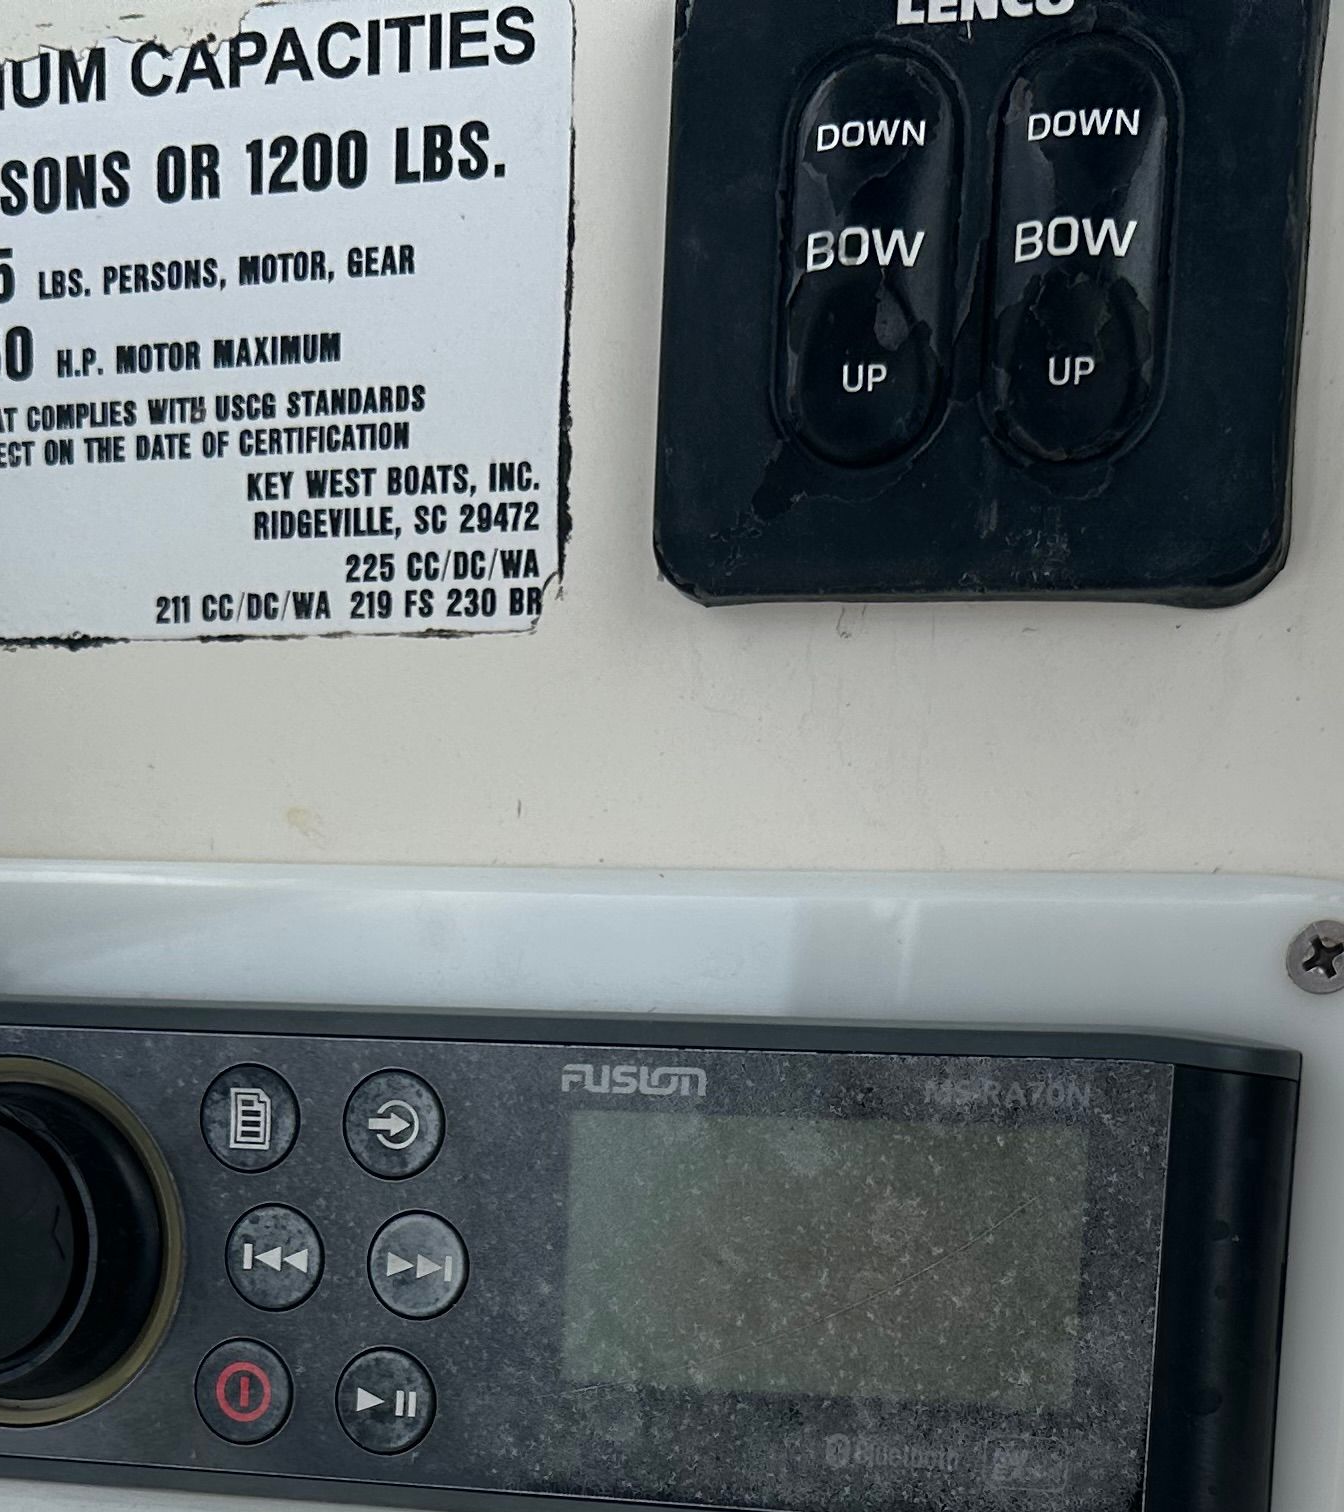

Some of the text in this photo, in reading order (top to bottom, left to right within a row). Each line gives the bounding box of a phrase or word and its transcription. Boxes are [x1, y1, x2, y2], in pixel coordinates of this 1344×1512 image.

[130, 5, 537, 97] CAPACITIES
[817, 120, 925, 151] DOWN
[1028, 108, 1139, 141] DOWN
[157, 144, 220, 204] OR
[246, 130, 367, 195] 1200
[395, 121, 505, 184] LBS.
[807, 227, 924, 272] BOW
[1015, 217, 1137, 263] BOW
[39, 268, 90, 300] LBS.
[104, 258, 226, 295] PERSONS,
[239, 250, 334, 286] MOTOR,
[348, 245, 414, 278] GEAR
[57, 347, 103, 378] H.P.
[116, 341, 200, 374] MOTOR
[214, 332, 340, 368] MAXIMUM
[1049, 357, 1094, 385] UP
[843, 364, 886, 392] UP
[27, 400, 136, 432] COMPLIES
[216, 393, 276, 422] USCG
[287, 385, 425, 418] STANDARDS
[44, 439, 74, 466] ON
[83, 436, 125, 463] THE
[136, 433, 191, 461] DATE
[202, 431, 229, 458] OF
[239, 422, 409, 456] CERTIFICATION
[247, 461, 539, 501] KEY WEST BOATS, INC.
[254, 501, 539, 540] RIDGEVILLE, SC 29472
[346, 548, 539, 582] 225 CC/DC/WA
[156, 586, 543, 624] 211 CC/DC/WA 219 FS 230 BR
[560, 1063, 707, 1096] FUSION
